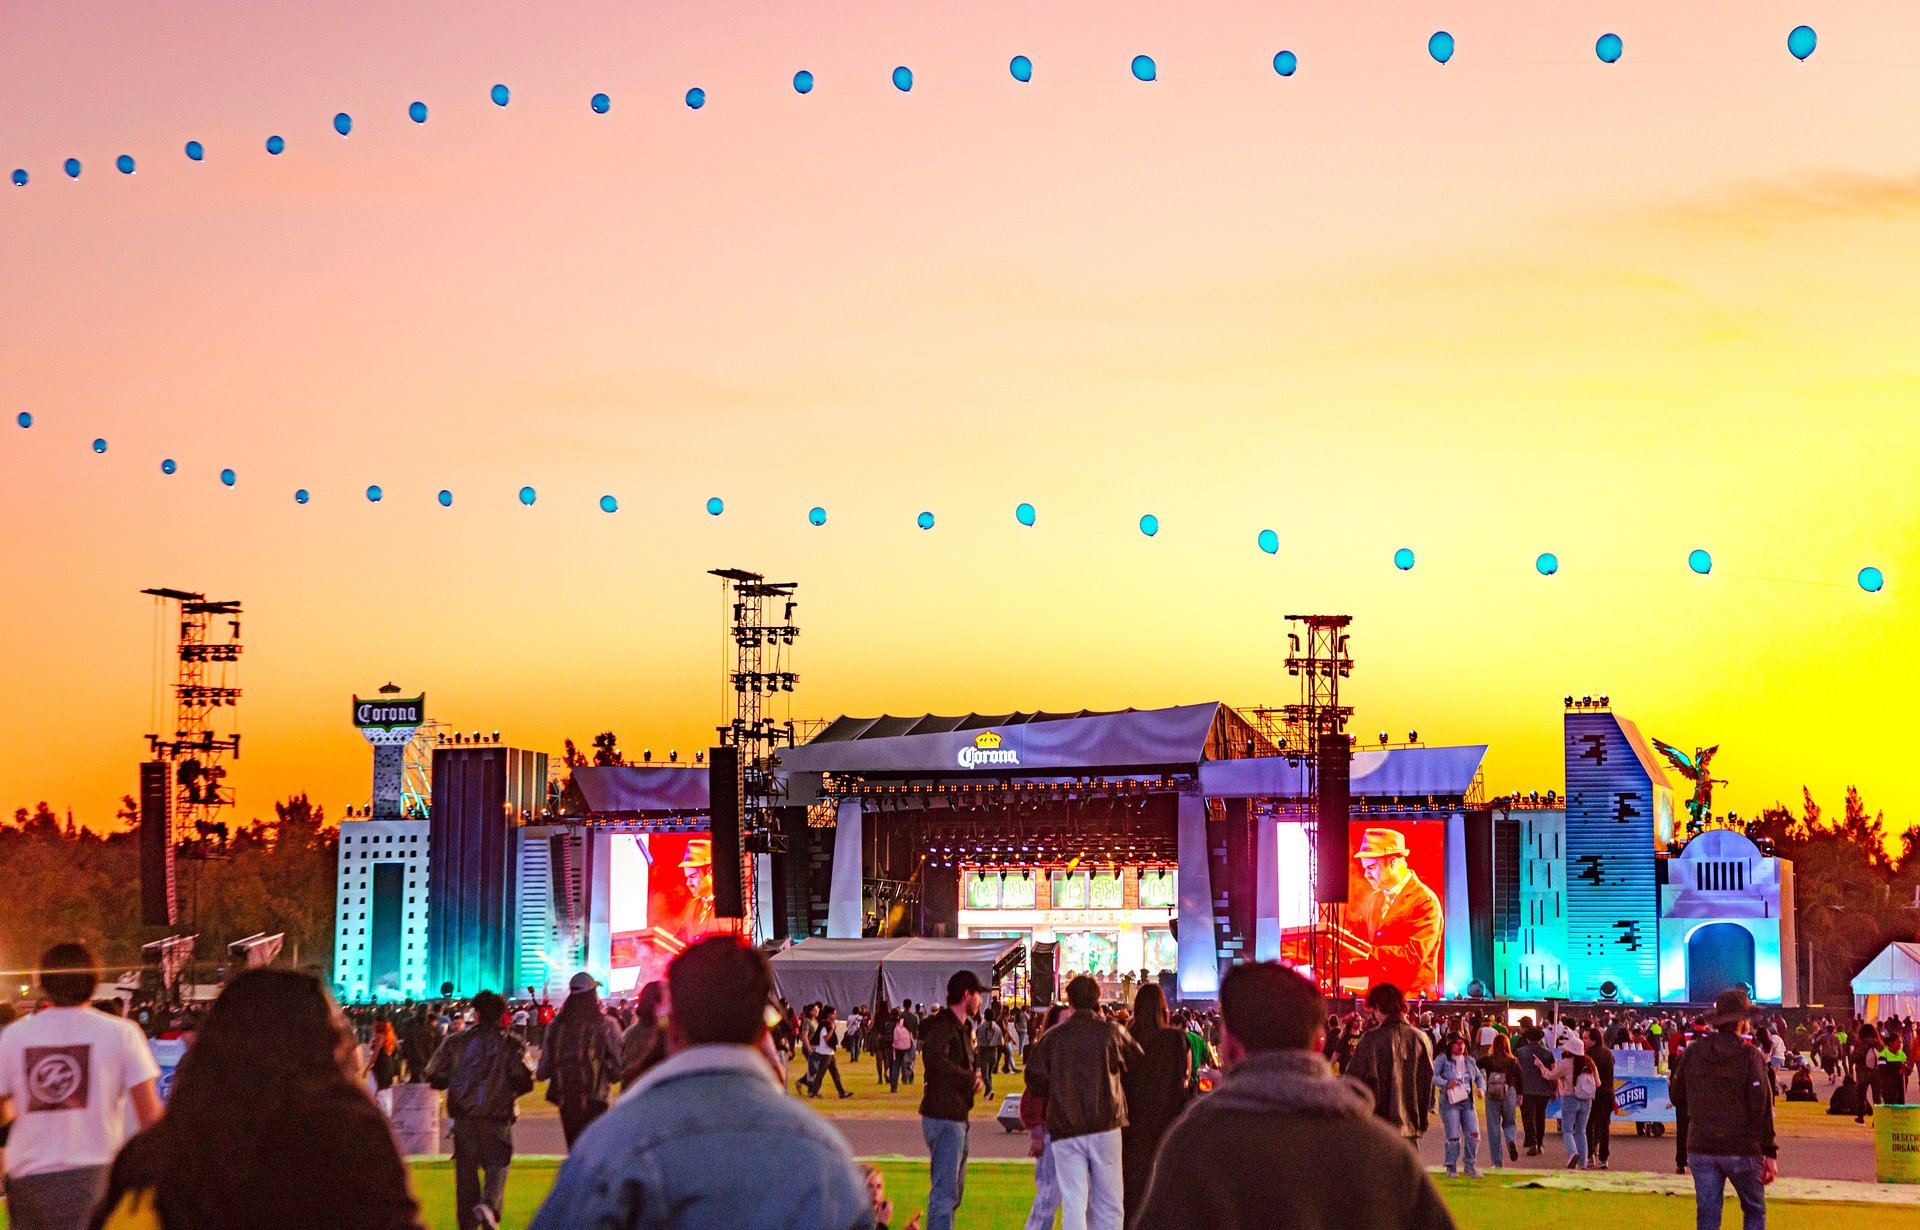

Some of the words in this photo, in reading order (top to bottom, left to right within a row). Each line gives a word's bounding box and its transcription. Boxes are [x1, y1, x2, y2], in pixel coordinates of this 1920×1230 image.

[357, 704, 417, 724] Corona
[957, 746, 1020, 769] Corona
[1626, 1087, 1645, 1103] FISH
